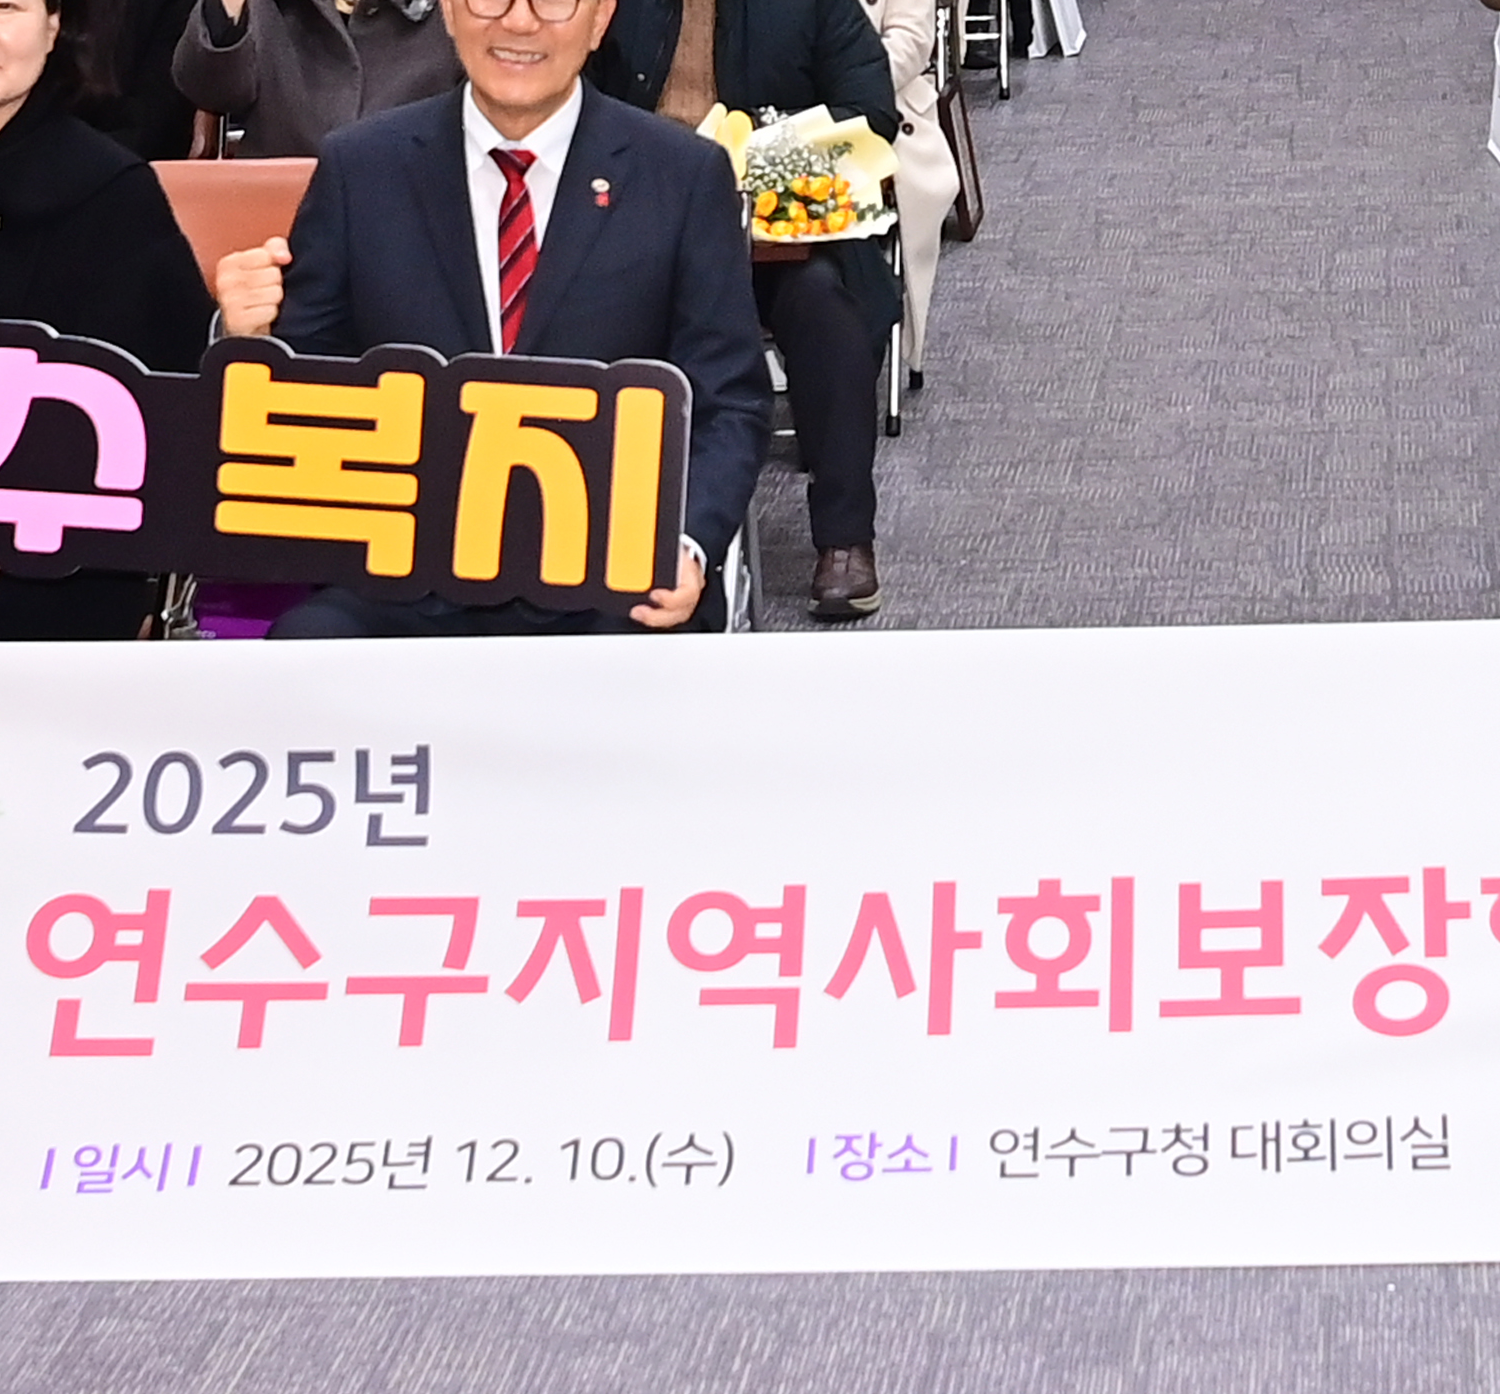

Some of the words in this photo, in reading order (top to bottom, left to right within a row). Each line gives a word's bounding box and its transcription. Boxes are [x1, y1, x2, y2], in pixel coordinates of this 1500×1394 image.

[216, 363, 664, 592] 복지
[73, 744, 431, 847] 2025년
[227, 1135, 433, 1191] 2025년
[456, 1138, 533, 1185] 12.
[560, 1131, 735, 1189] 10.(수)
[989, 1122, 1210, 1179] 연수구청
[1230, 1113, 1452, 1174] 대회의실
